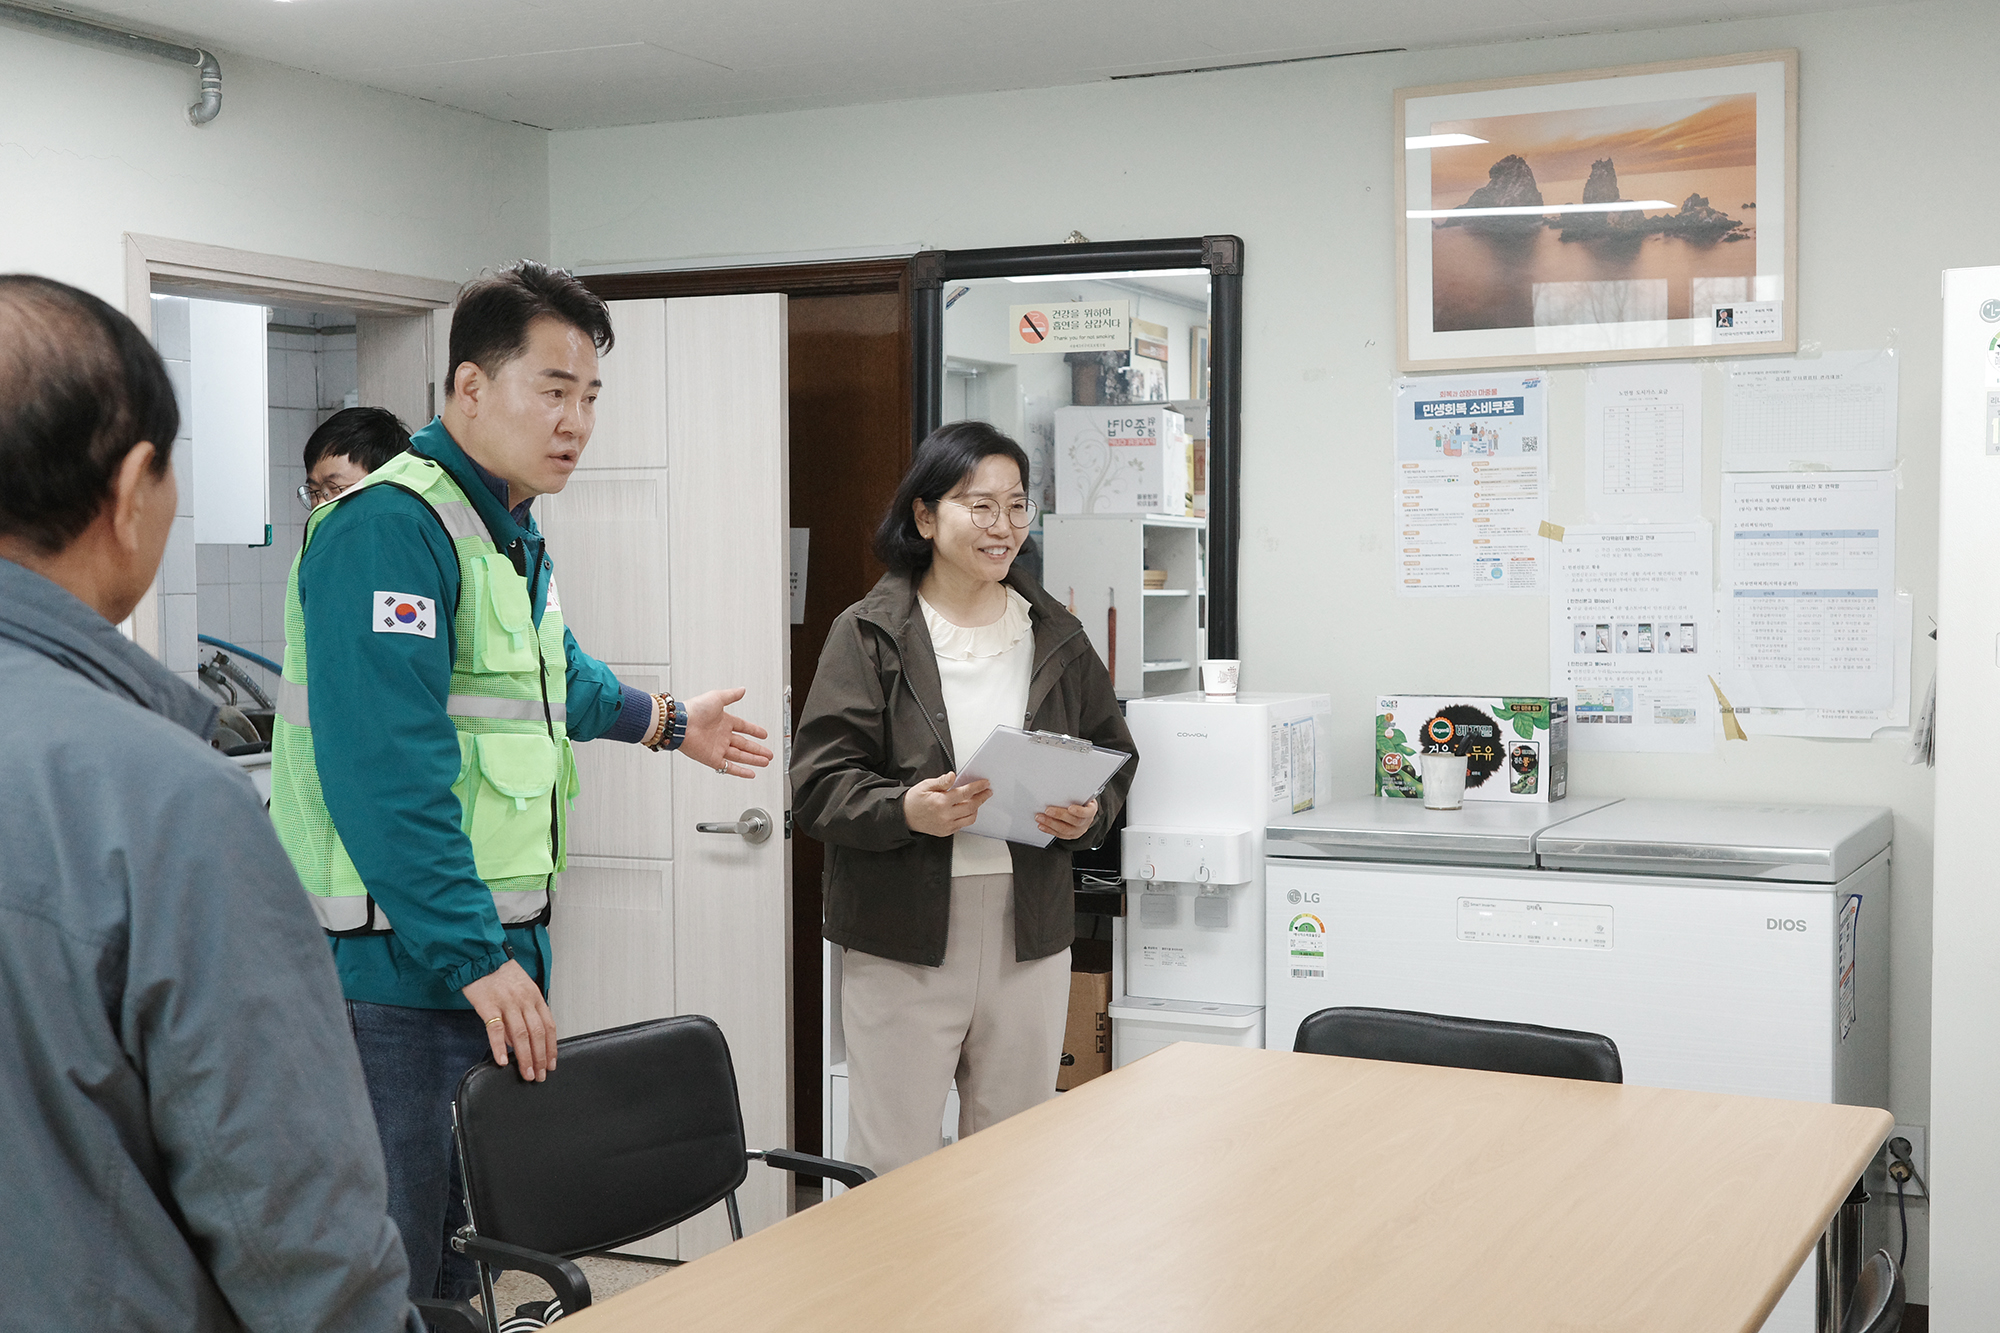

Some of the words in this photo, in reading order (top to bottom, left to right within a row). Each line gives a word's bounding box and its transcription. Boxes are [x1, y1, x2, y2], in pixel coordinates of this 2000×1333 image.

[1052, 309, 1079, 319] 건강을
[1084, 308, 1112, 317] 위하여
[1053, 321, 1079, 330] 흡연을
[1423, 403, 1466, 417] 민생회복
[1469, 400, 1515, 415] 소비쿠폰
[1471, 746, 1494, 761] 두유
[1304, 892, 1320, 903] LG
[1766, 918, 1807, 932] DIOS
